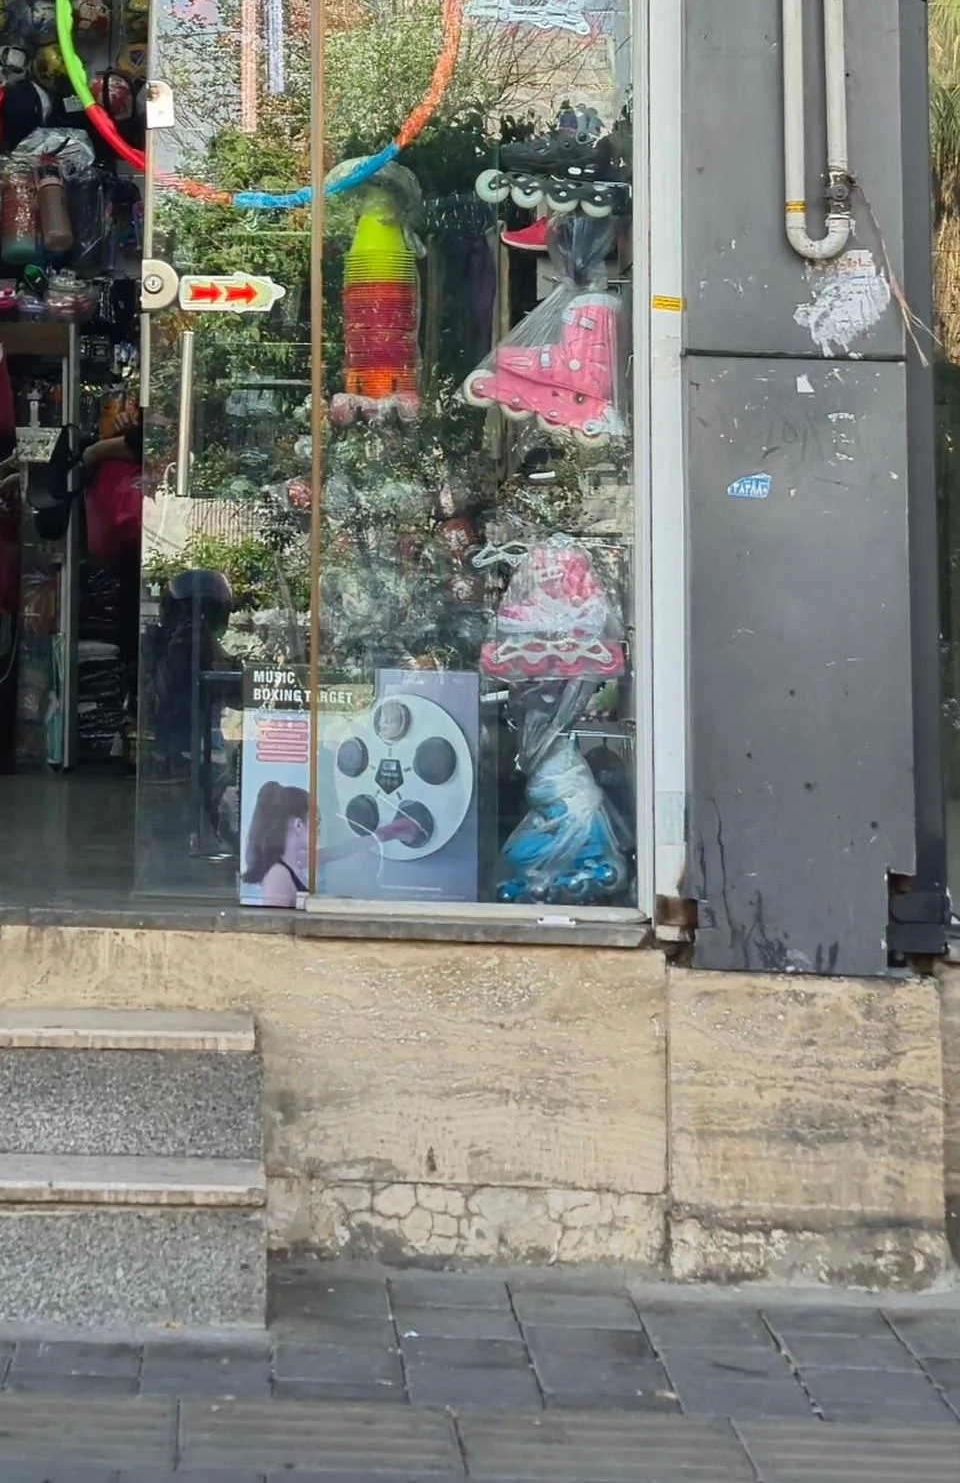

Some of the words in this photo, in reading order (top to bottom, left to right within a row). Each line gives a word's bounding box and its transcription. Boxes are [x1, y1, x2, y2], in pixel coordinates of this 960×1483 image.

[253, 670, 295, 684] MUSIC
[253, 688, 301, 702] BOXING
[302, 690, 354, 704] TRGET
